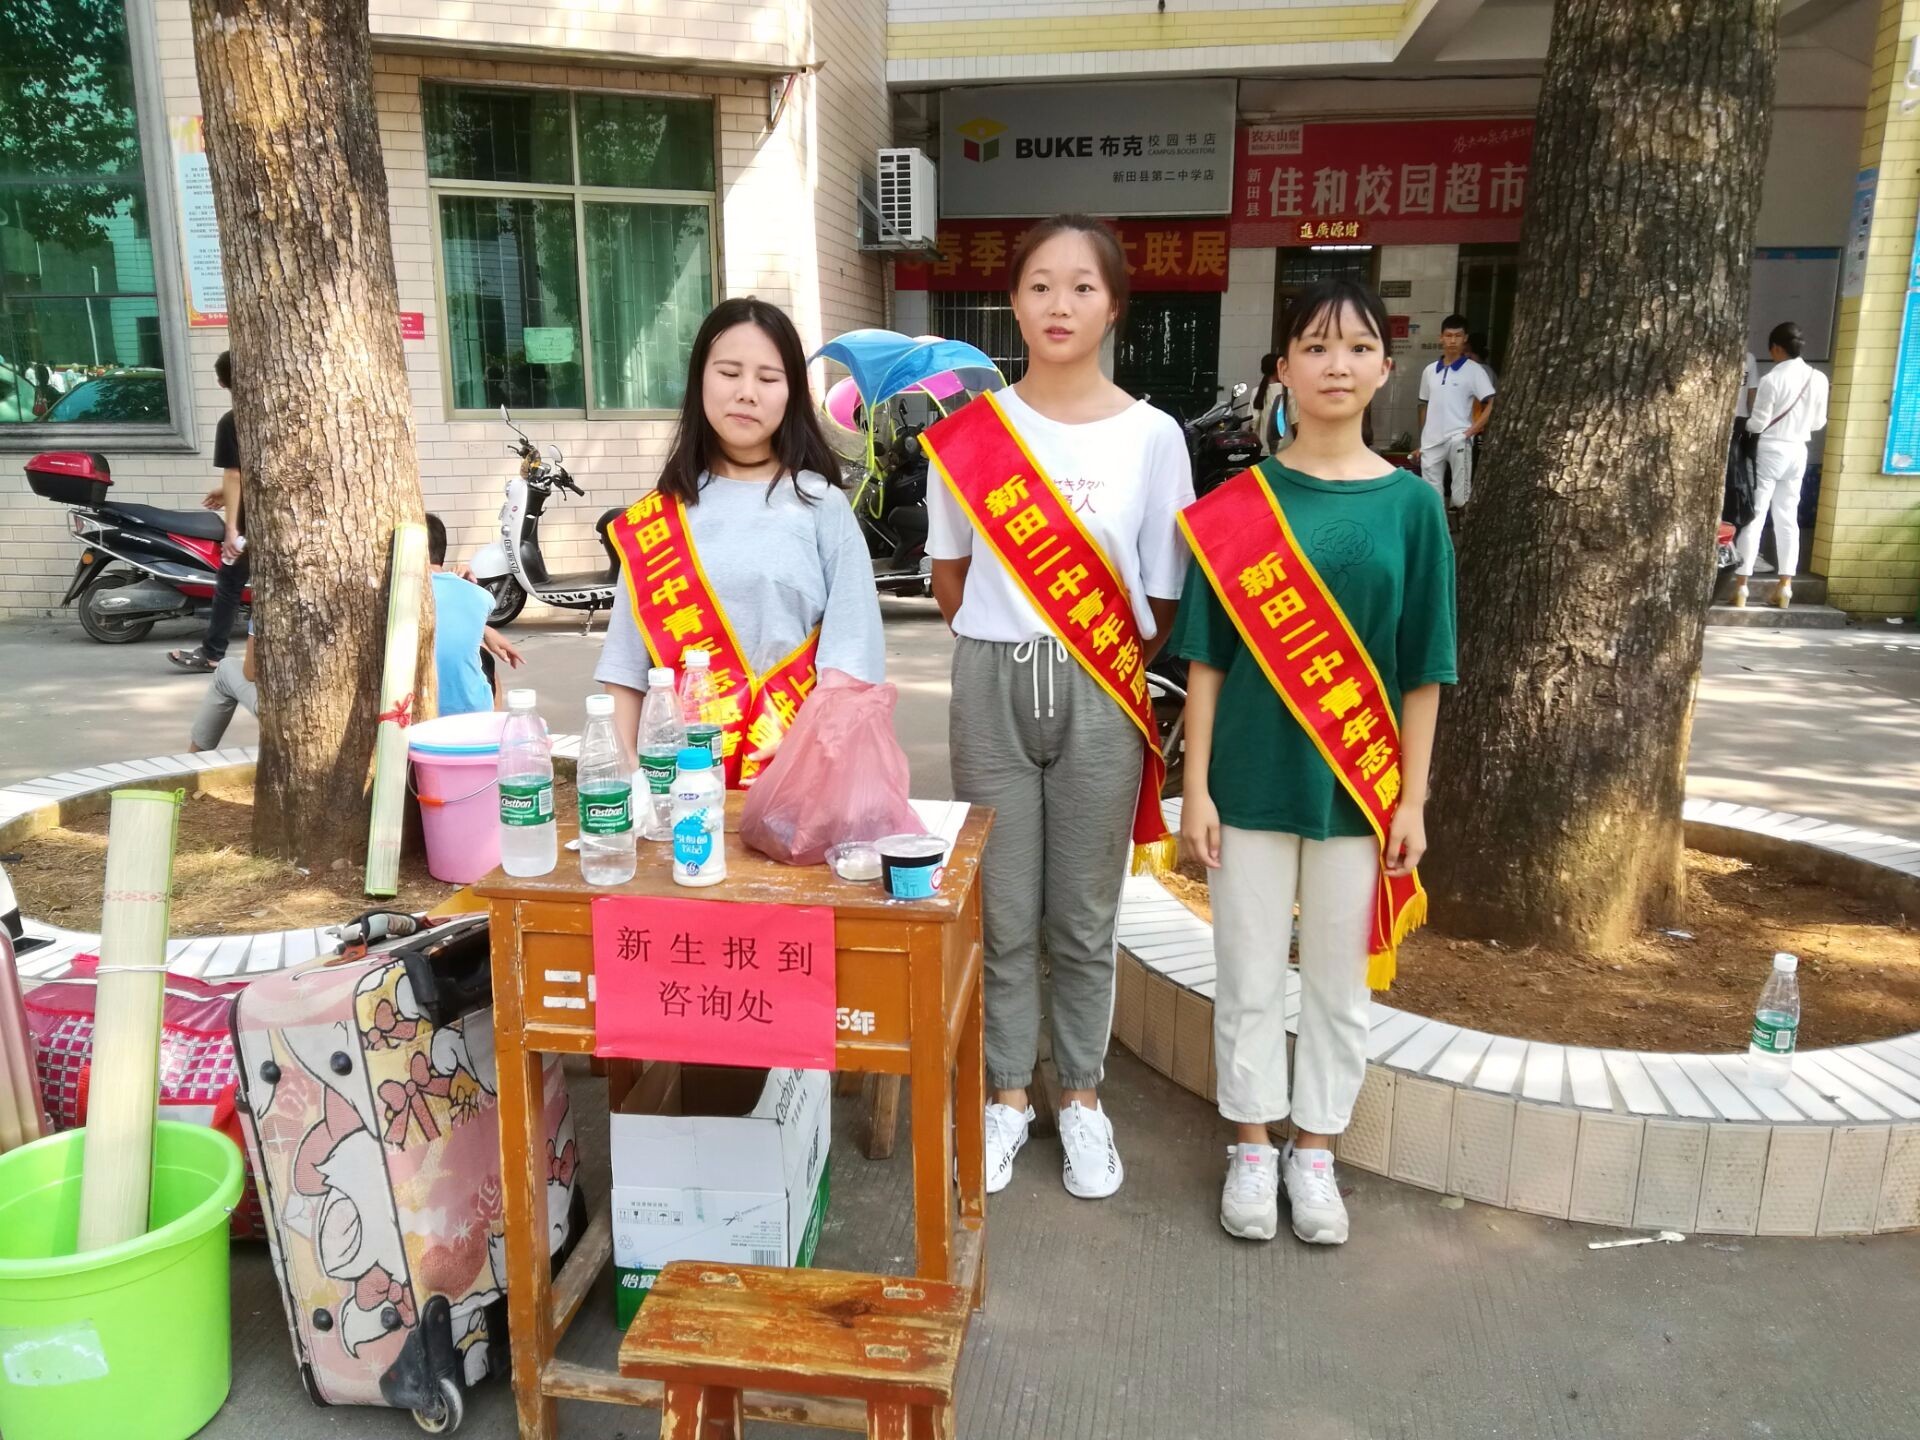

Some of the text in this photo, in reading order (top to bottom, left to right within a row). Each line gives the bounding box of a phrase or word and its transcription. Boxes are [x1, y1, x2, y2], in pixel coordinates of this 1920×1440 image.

[1016, 133, 1216, 159] BUKE 布克 校园书店
[1113, 169, 1215, 183] 新田县第二中学店
[1246, 168, 1261, 217] 新田县
[1268, 161, 1528, 217] 佳和校园超市
[615, 925, 814, 977] 新生报到
[657, 980, 774, 1024] 咨询处
